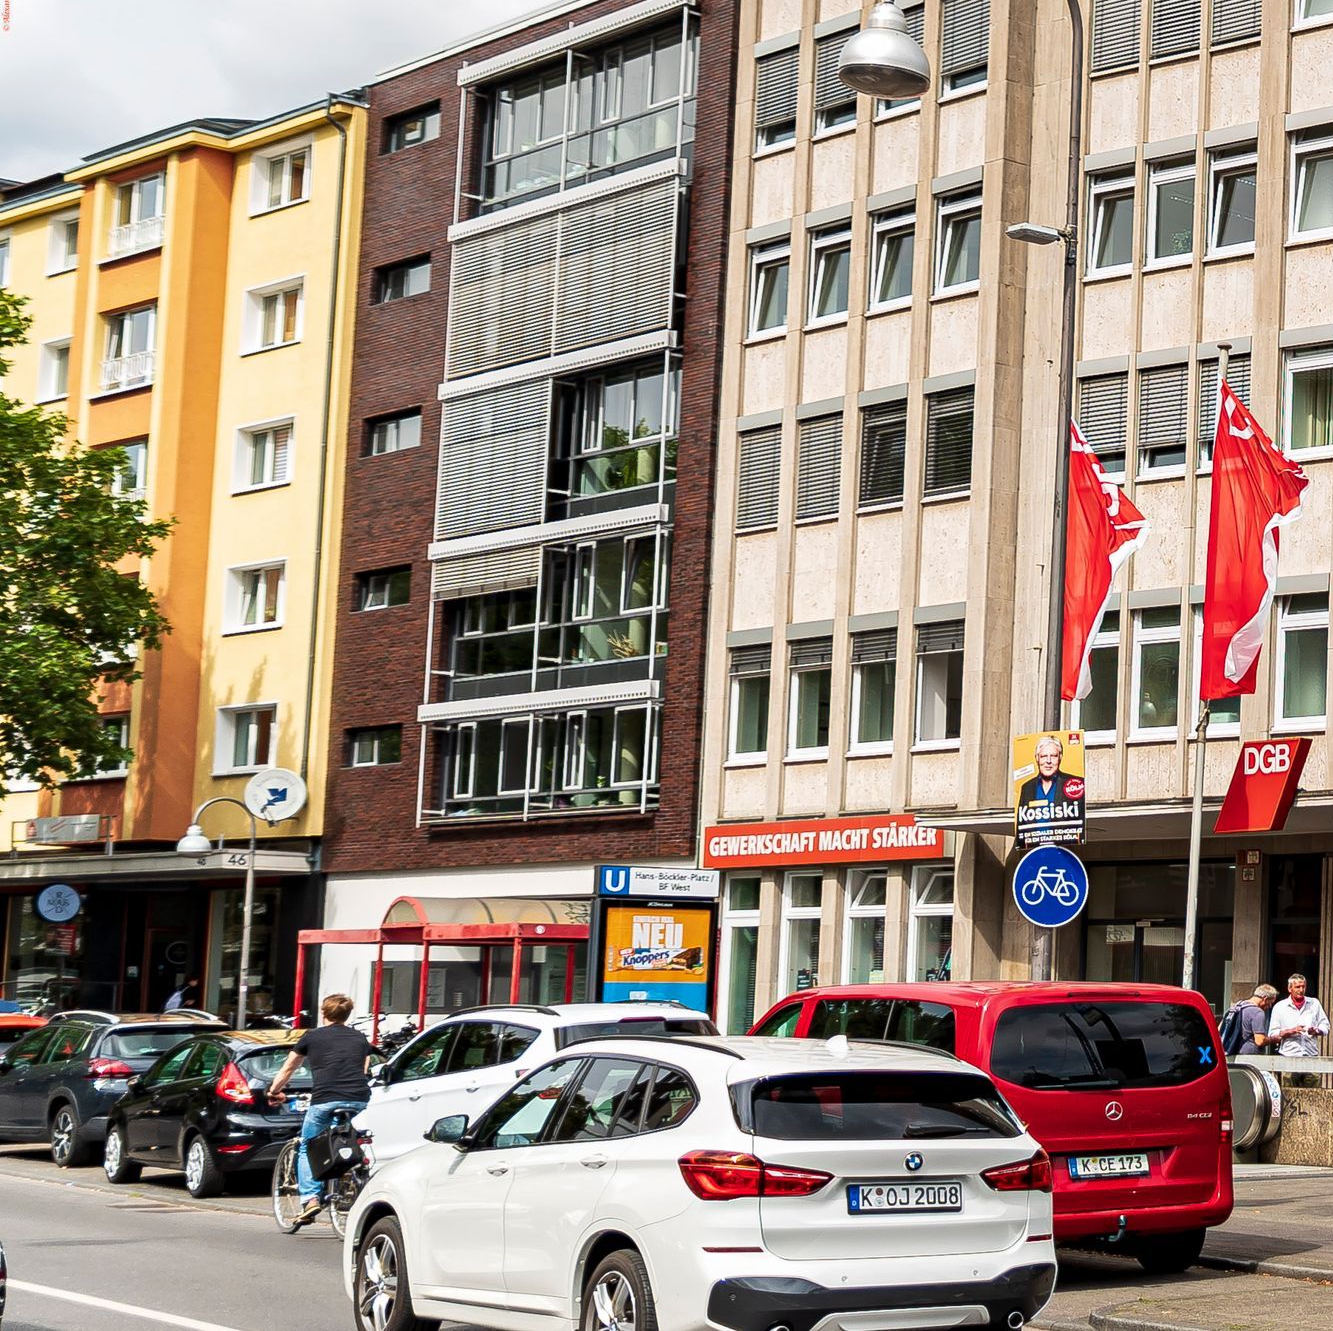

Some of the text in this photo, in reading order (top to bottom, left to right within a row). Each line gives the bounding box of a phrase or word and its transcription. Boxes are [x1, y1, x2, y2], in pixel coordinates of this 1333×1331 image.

[1244, 743, 1291, 775] DGB
[1018, 801, 1079, 822] Kossiski
[709, 821, 937, 857] GEWERKSCHAFT MACHT STÄRKER
[228, 856, 247, 866] 46
[606, 870, 626, 892] U
[635, 872, 710, 882] Hans-Böckler-Platz
[659, 883, 691, 892] BF West
[632, 922, 683, 949] NEU
[623, 950, 670, 966] Knoppers
[1081, 1156, 1143, 1173] K CE 173
[861, 1186, 959, 1207] K OJ 2008
